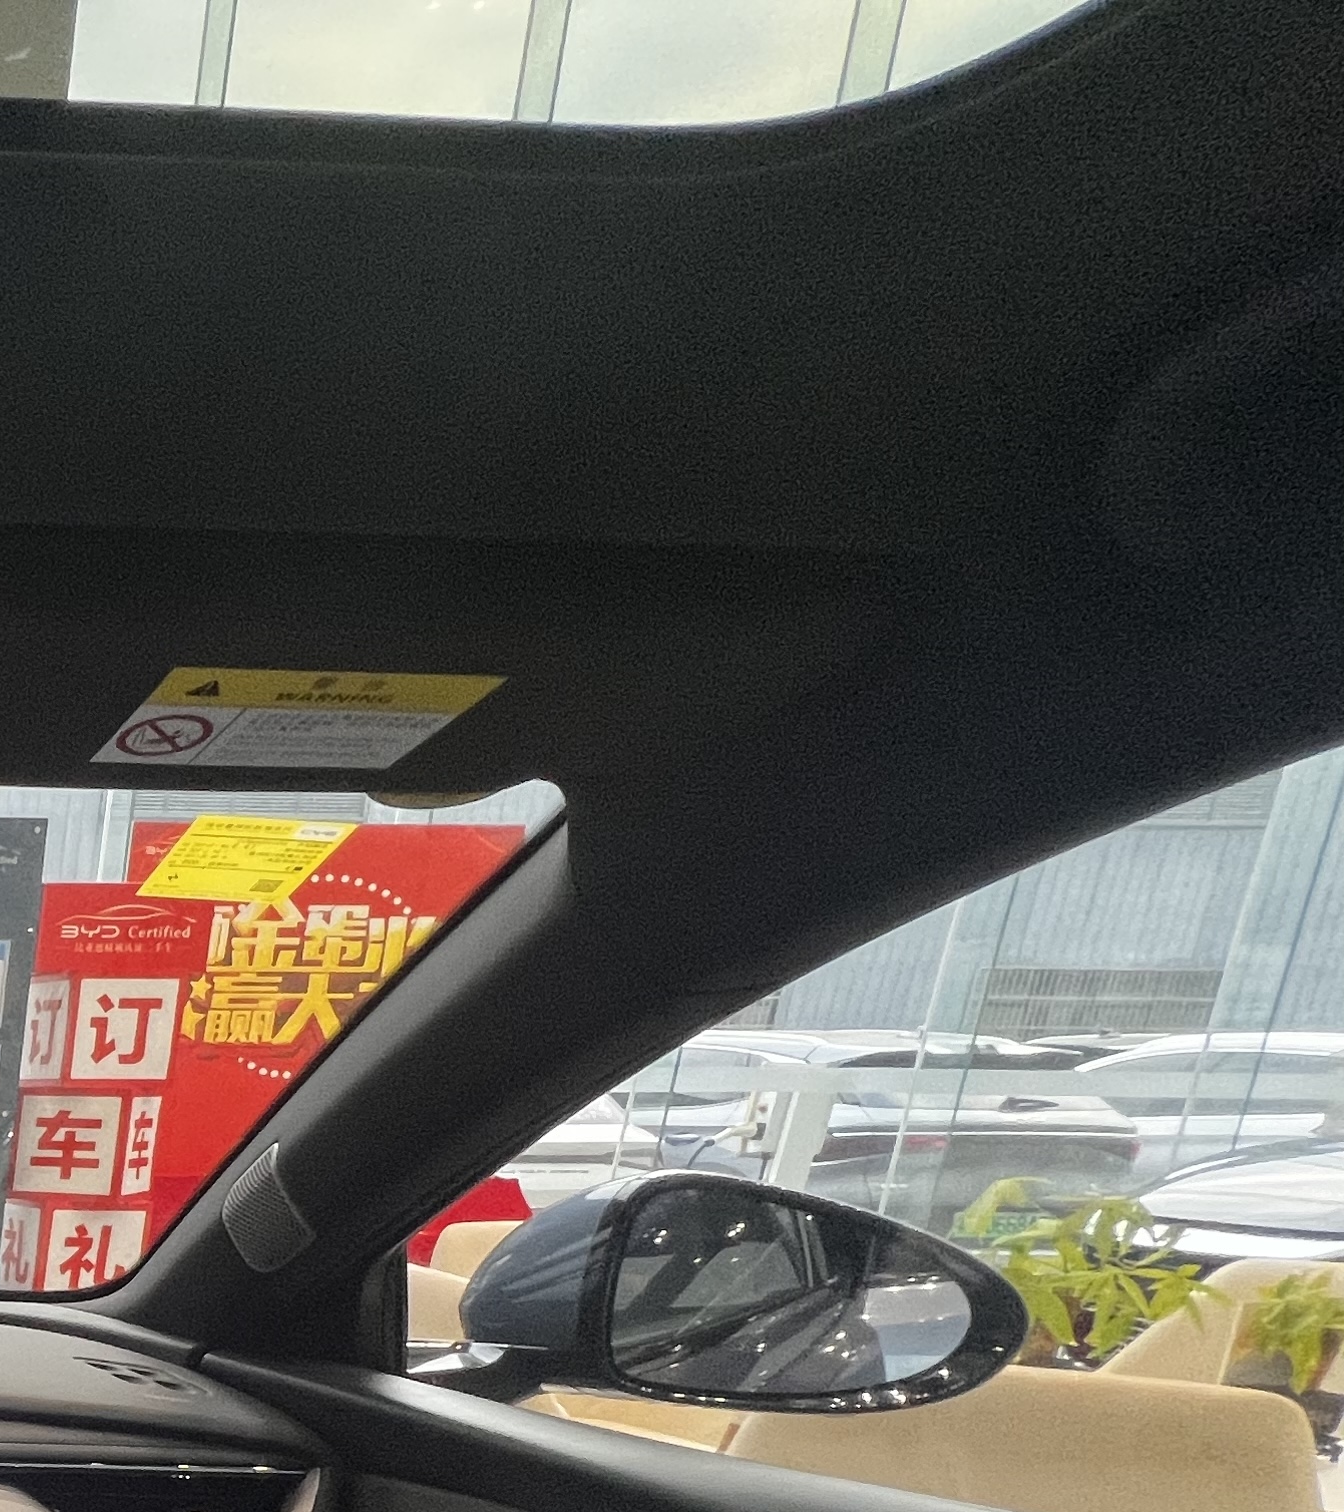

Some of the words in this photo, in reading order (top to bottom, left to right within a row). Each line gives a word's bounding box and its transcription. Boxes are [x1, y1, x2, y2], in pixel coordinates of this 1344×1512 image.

[60, 925, 120, 939] BYD
[128, 925, 192, 939] Certified
[90, 993, 163, 1065] 订
[204, 972, 379, 1044] 赢大
[30, 1109, 102, 1180] 车
